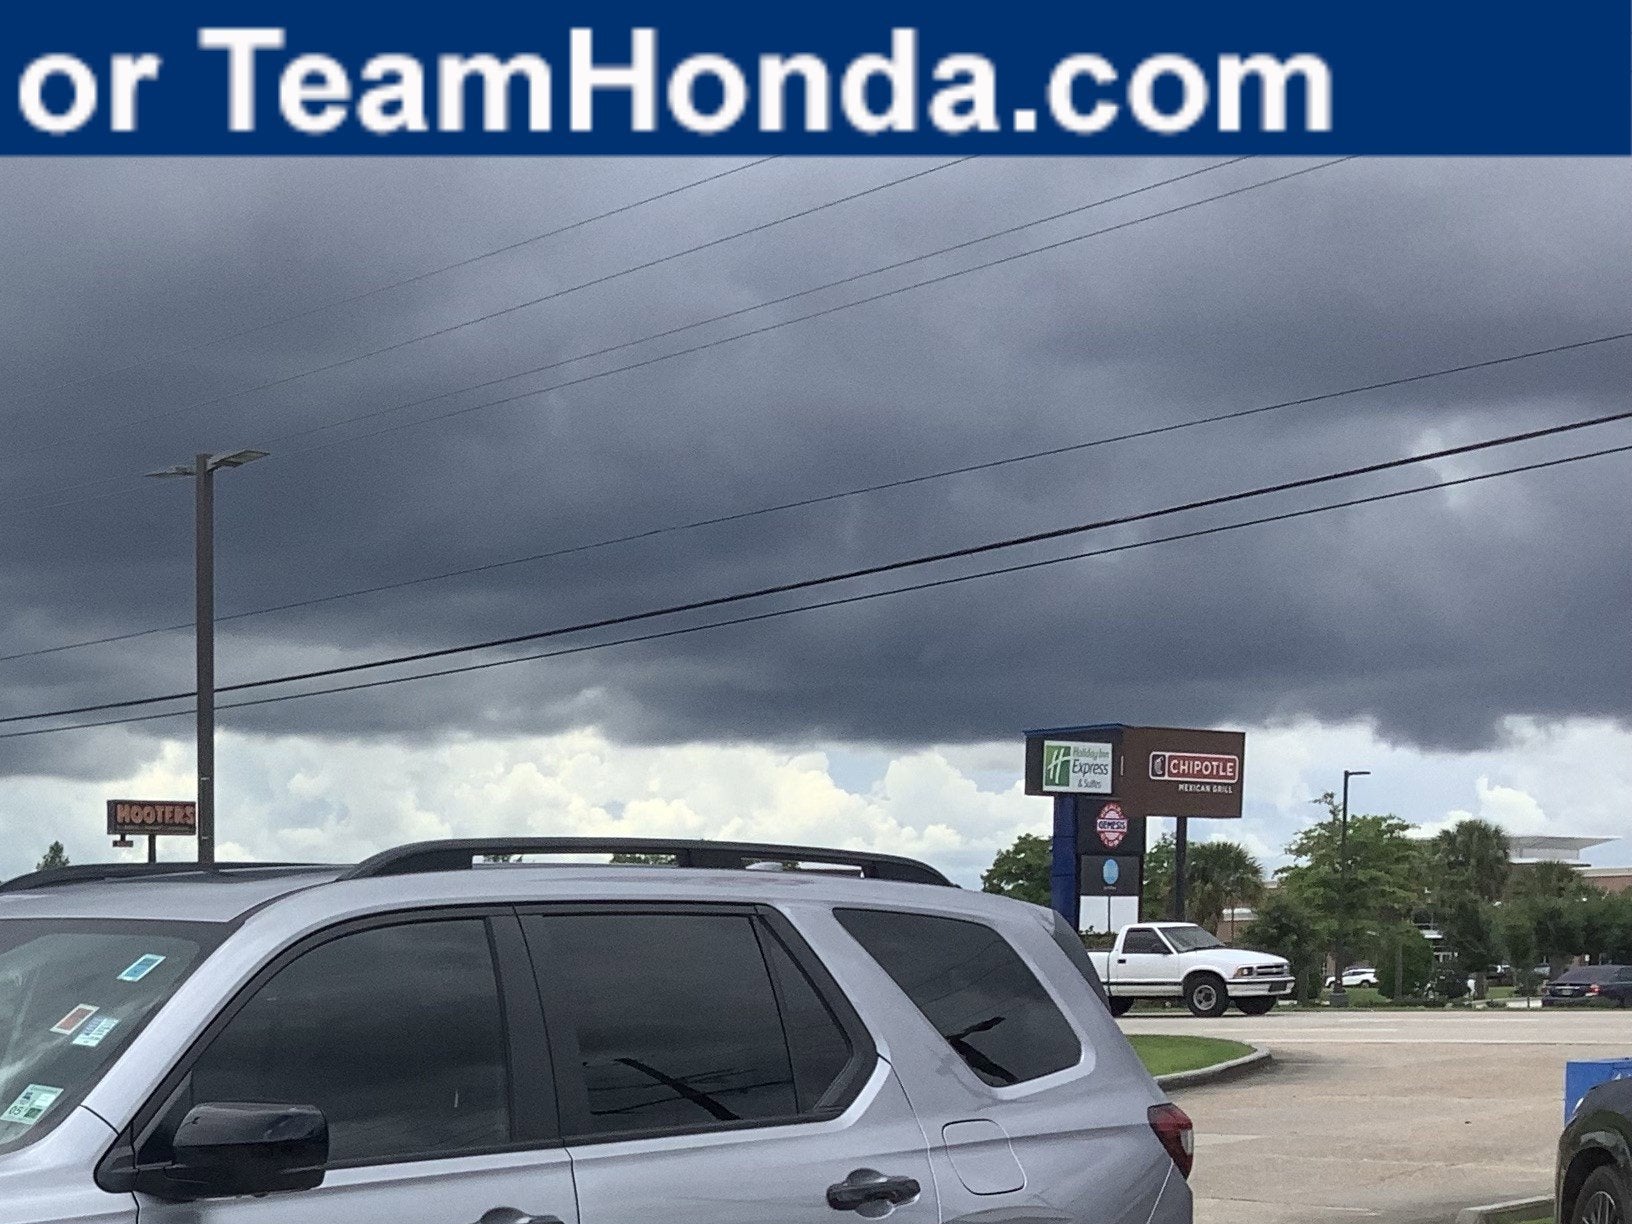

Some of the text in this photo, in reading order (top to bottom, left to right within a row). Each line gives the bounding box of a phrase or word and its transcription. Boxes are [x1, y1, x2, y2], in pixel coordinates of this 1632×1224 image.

[1072, 759, 1109, 777] Express
[1169, 759, 1234, 776] CHIPOTLE
[1178, 783, 1233, 794] MEXICAN GRILL
[116, 804, 196, 824] HOOTERS
